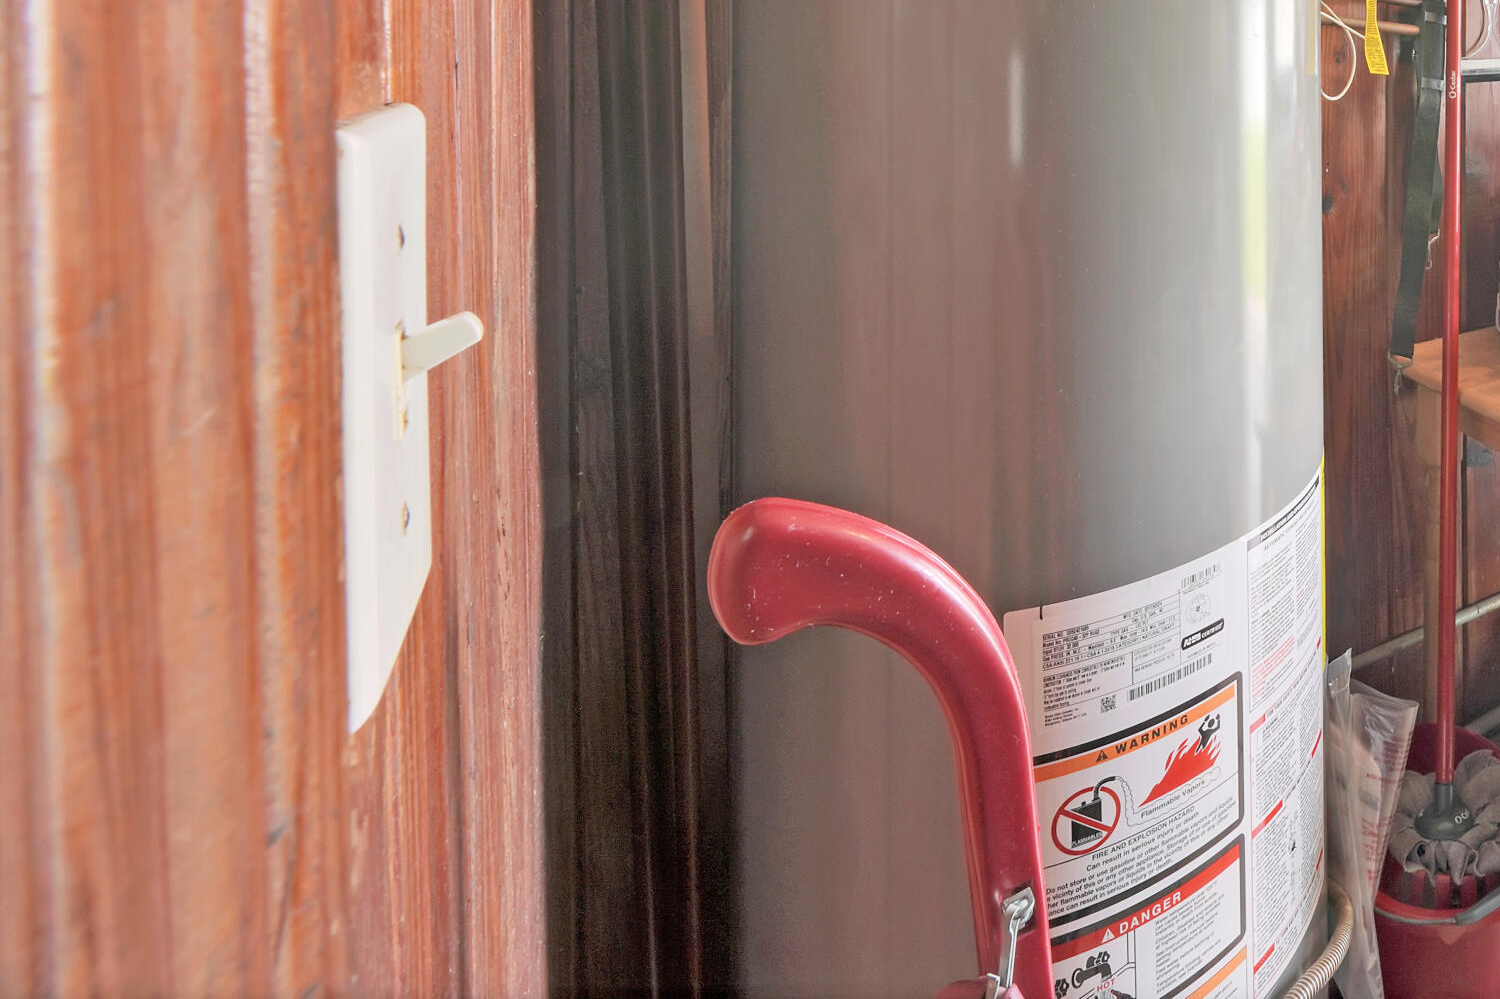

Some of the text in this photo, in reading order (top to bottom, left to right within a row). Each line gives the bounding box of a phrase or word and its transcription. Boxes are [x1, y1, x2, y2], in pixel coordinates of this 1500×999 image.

[1115, 715, 1188, 755] WARNING
[1141, 780, 1205, 818] Flammable Vapors
[1086, 862, 1100, 871] Can
[1102, 854, 1122, 866] result
[1132, 837, 1155, 851] serious
[1157, 828, 1174, 841] injury
[1092, 806, 1195, 860] FIRE AND EXPLOSION HAZARD
[1057, 883, 1068, 891] not
[1070, 877, 1087, 887] store
[1097, 868, 1108, 876] use
[1110, 857, 1136, 873] gasoline
[1145, 845, 1160, 856] other
[1076, 884, 1082, 892] of
[1084, 879, 1096, 889] this
[1120, 891, 1181, 935] DANGER
[1097, 978, 1116, 992] HOT
